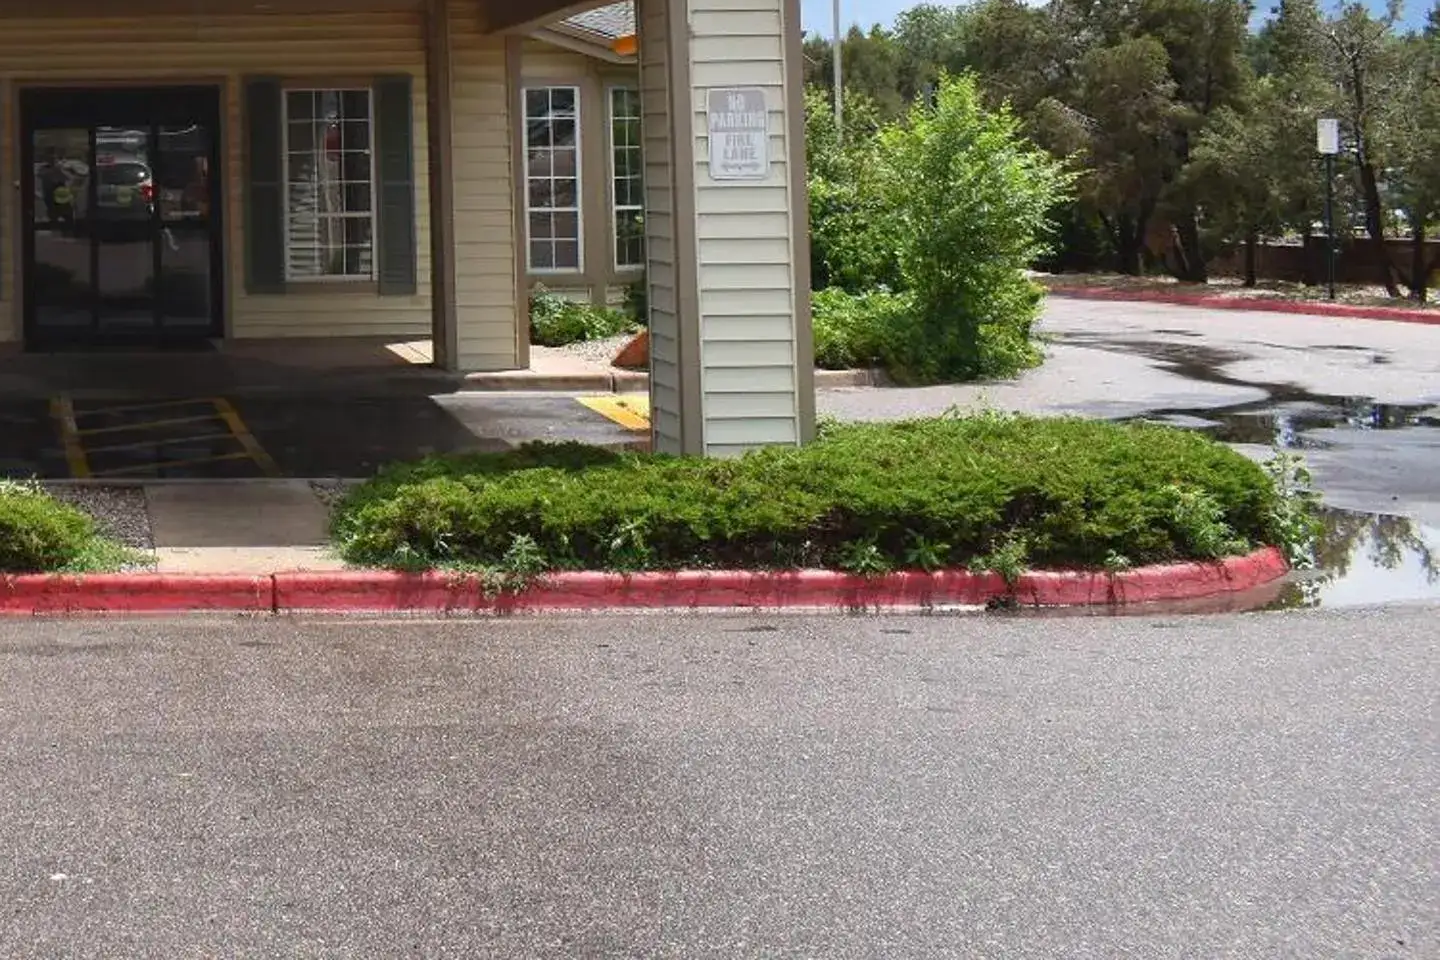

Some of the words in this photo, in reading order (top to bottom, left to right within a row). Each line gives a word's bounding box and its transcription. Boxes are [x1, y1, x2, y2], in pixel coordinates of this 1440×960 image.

[727, 93, 746, 111] NO
[710, 112, 765, 128] PARKING
[724, 133, 754, 147] FIRE
[723, 147, 758, 160] LANE
